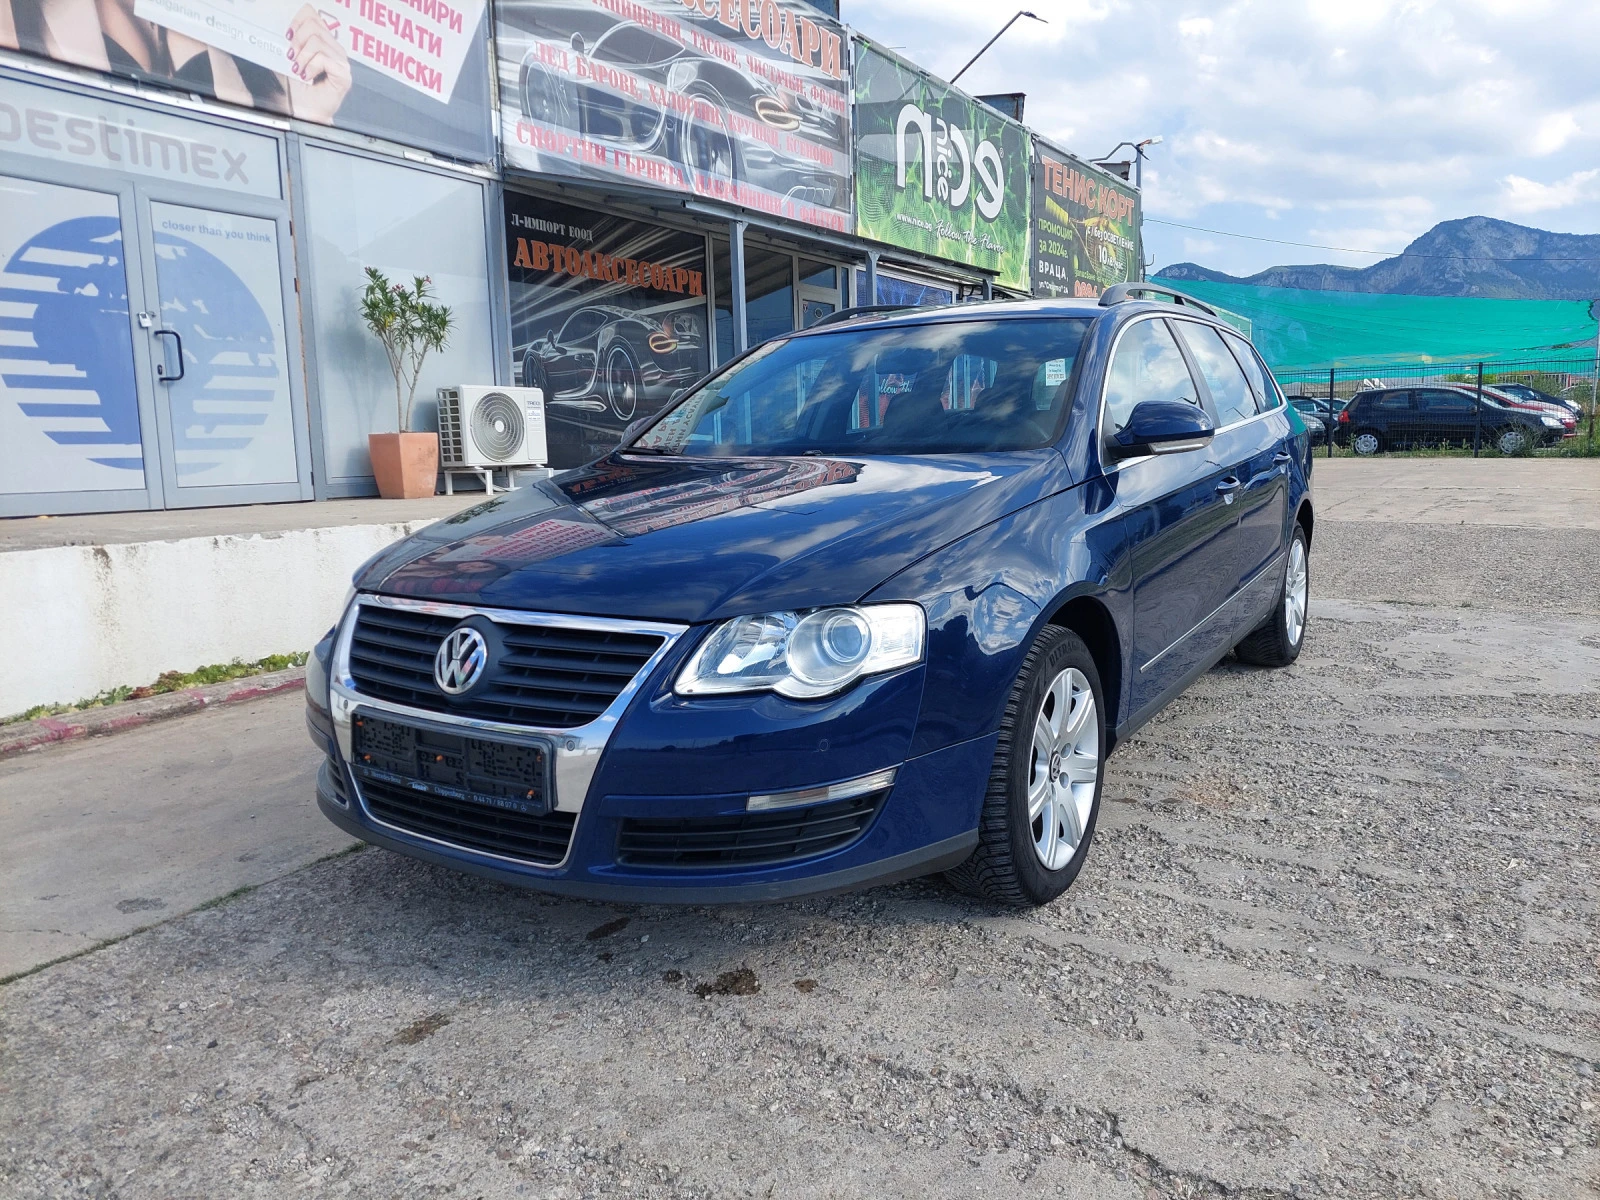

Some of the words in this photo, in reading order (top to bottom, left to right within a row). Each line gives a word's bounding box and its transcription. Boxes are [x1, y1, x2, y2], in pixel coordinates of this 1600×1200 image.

[206, 15, 244, 40] design
[249, 34, 283, 57] centre
[359, 0, 442, 58] ПЕЧАТИ
[400, 0, 463, 34] НИРИ
[349, 26, 442, 93] ТЕНИСКИ
[691, 29, 742, 69] ТАСОВЕ,
[533, 41, 569, 75] ЛЕД
[576, 55, 643, 101] БАРОВЕ,
[516, 120, 607, 166] СПОРТНИ
[613, 149, 690, 191] ГЪРНЕТА,
[787, 201, 795, 218] И
[800, 206, 845, 232] ФИЛТРИ
[1042, 155, 1097, 209] ТЕНИС
[1098, 184, 1134, 227] КОРТ
[162, 219, 196, 234] closer
[198, 223, 222, 238] than
[224, 229, 244, 243] you
[246, 231, 272, 244] think
[510, 213, 566, 238] Л-ИМПОРТ
[569, 226, 594, 243] ЕООД
[935, 219, 962, 240] Follow
[1038, 218, 1073, 241] ПРОМОЦИЯ
[513, 237, 704, 296] АВТОАКСЕСОАРИ
[1038, 260, 1069, 282] ВРАЦА,
